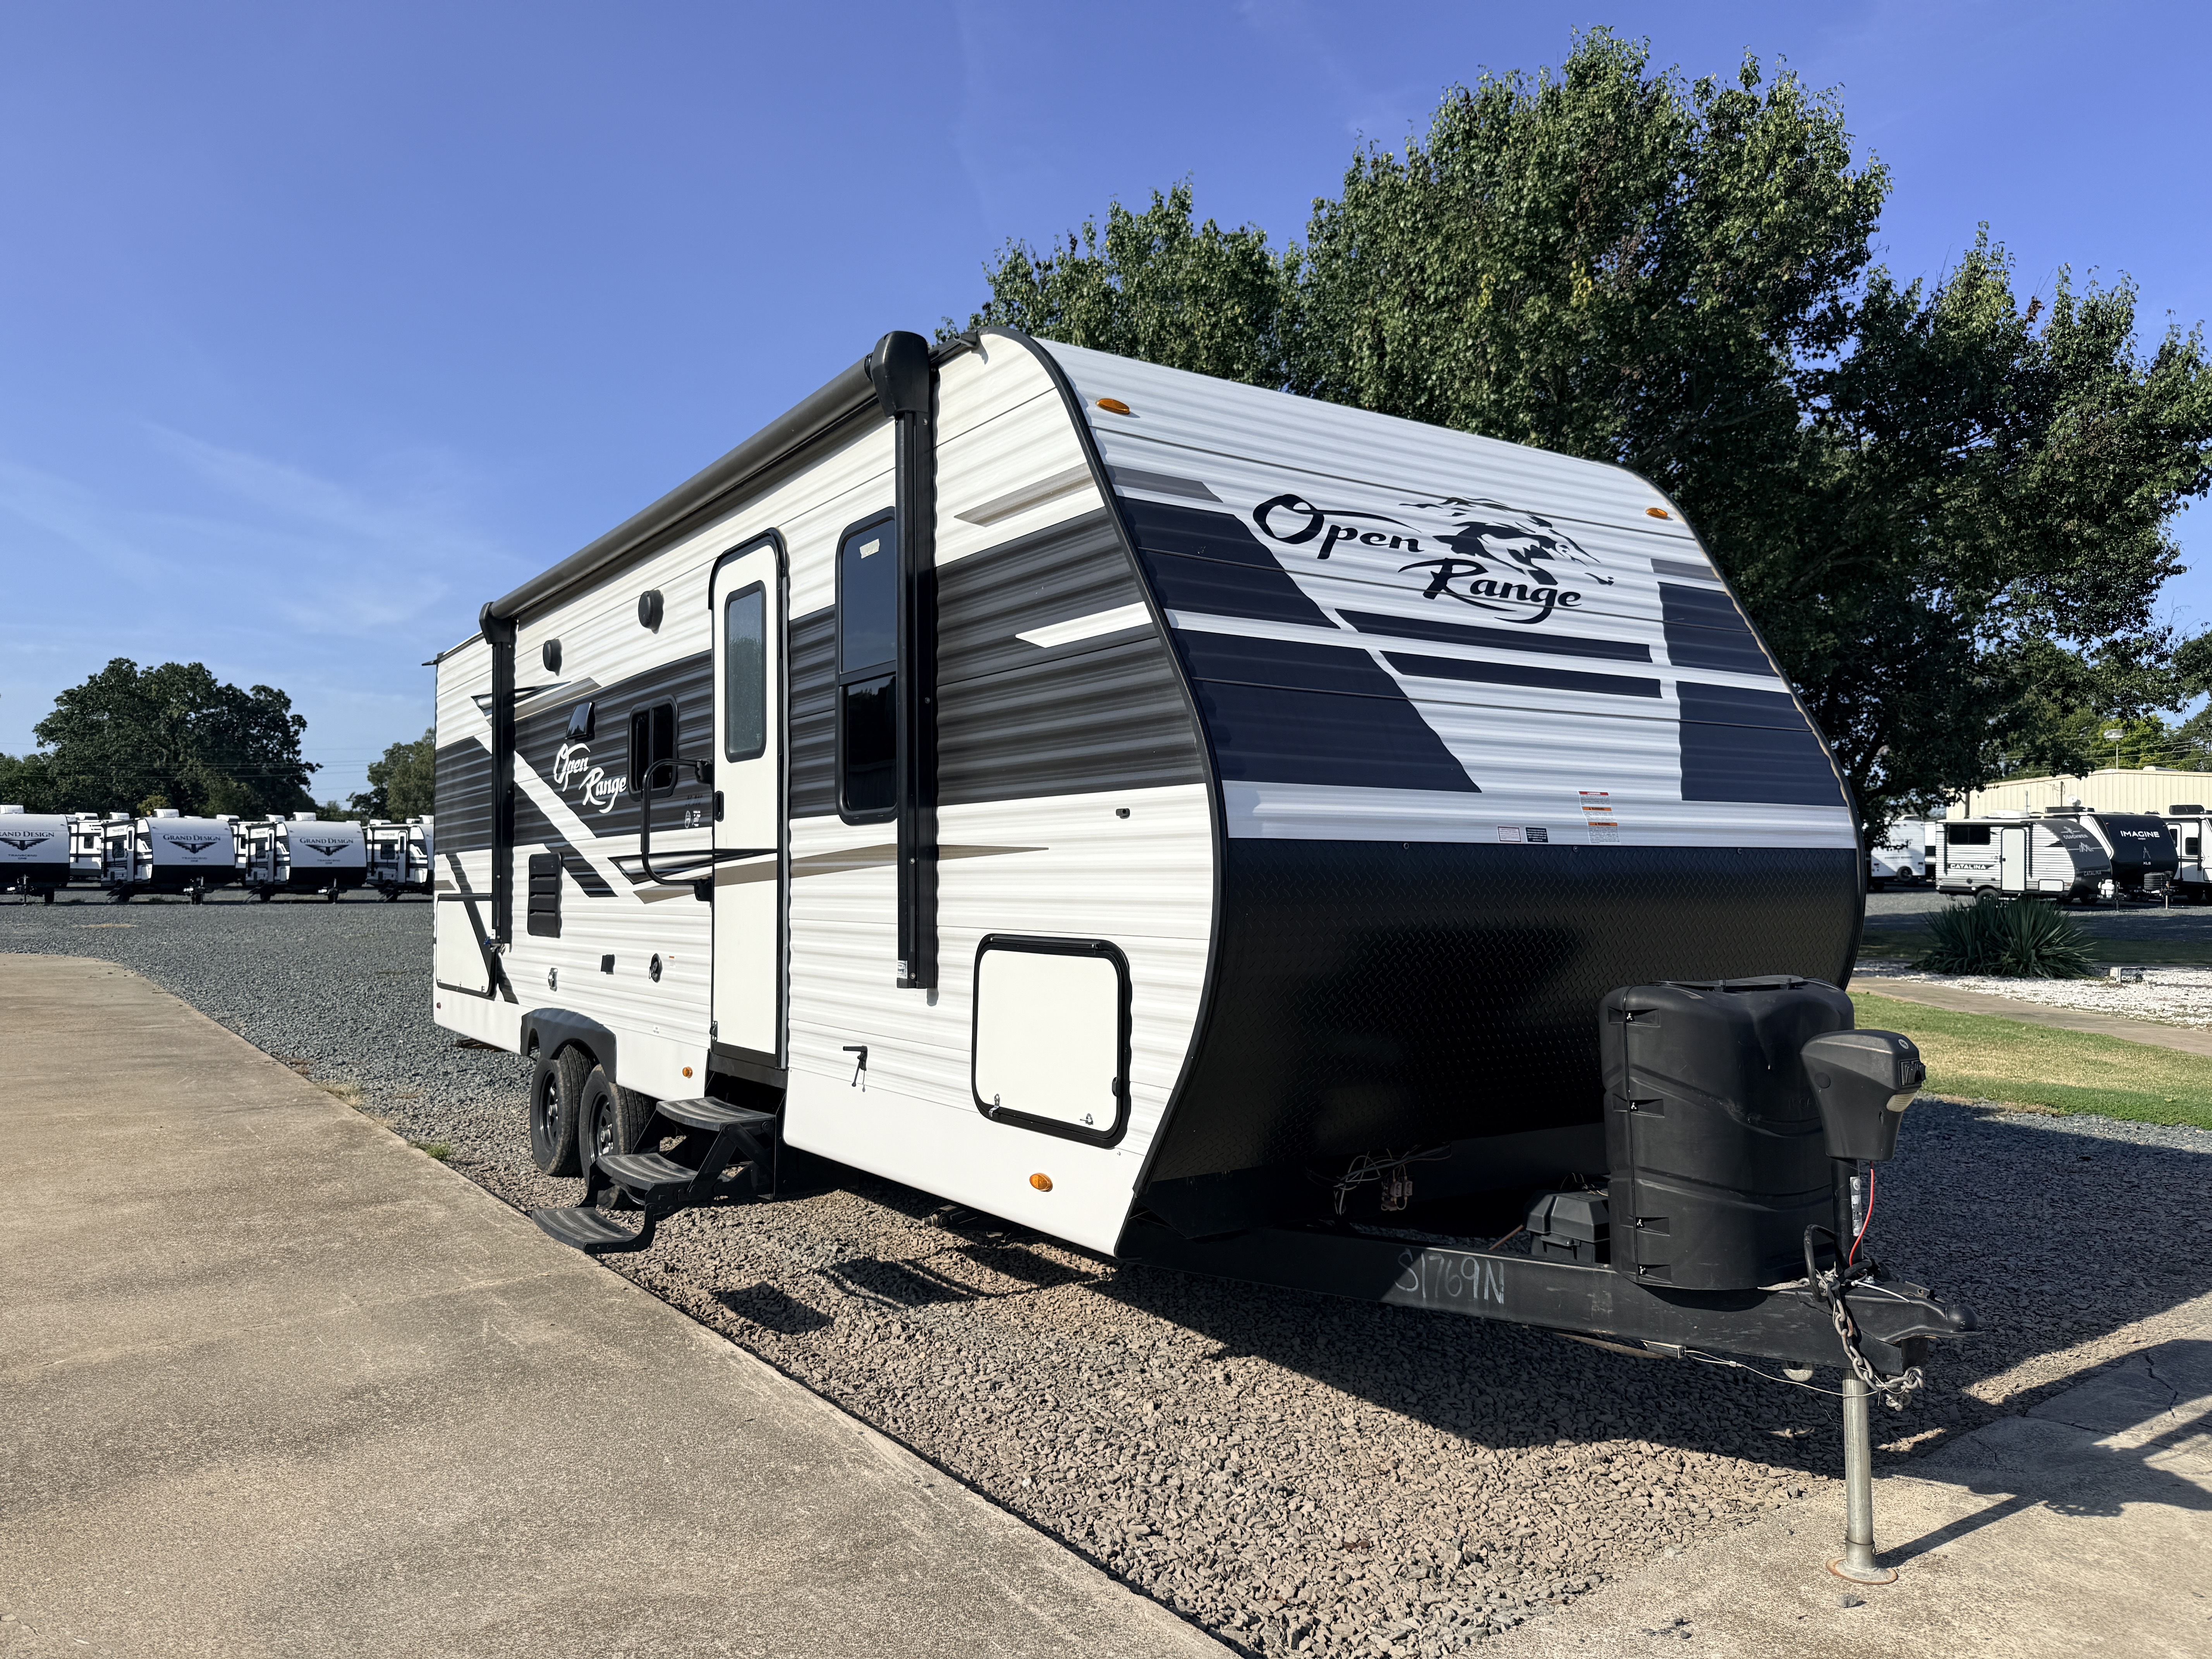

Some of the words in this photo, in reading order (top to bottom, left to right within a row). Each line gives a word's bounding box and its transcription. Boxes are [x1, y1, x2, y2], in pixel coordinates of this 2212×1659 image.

[1253, 494, 1424, 560] Open
[1398, 558, 1581, 624] Range
[553, 743, 591, 792] Open
[579, 767, 627, 814] Range
[1395, 1248, 1504, 1304] S1769N
